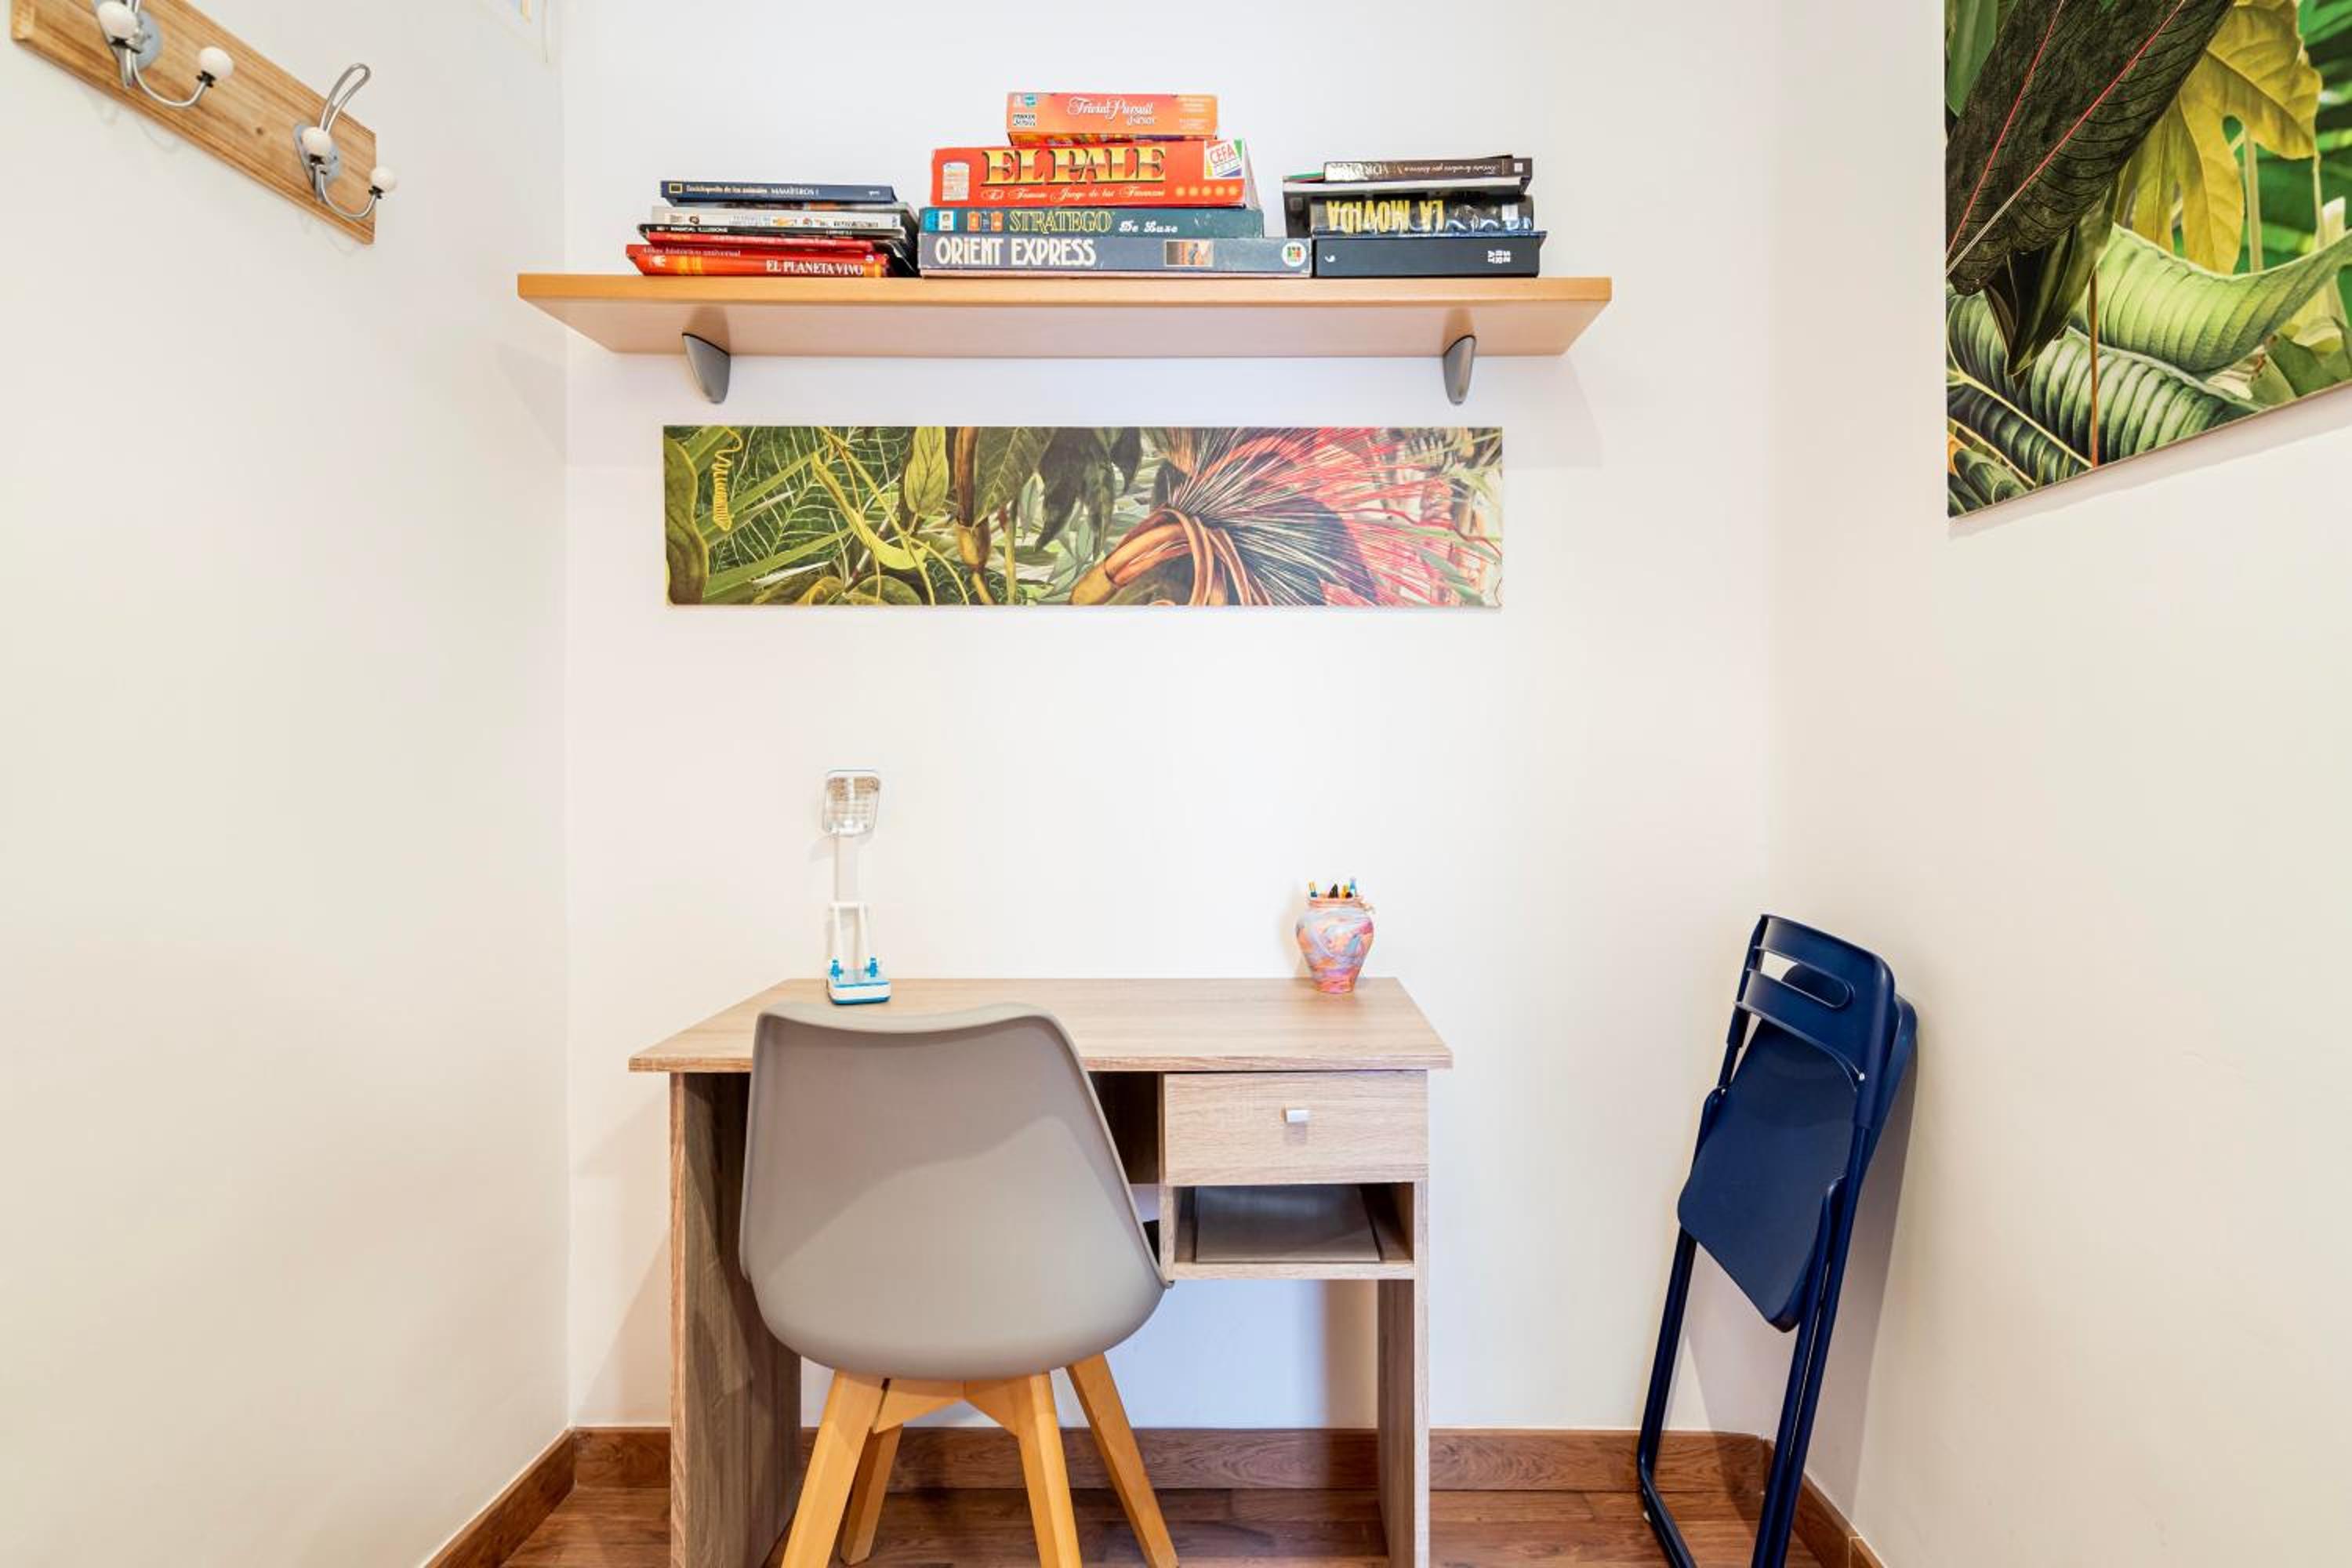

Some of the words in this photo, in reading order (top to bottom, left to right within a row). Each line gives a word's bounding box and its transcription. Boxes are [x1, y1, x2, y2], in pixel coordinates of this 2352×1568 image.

[1067, 96, 1111, 114] Trivial
[1105, 96, 1154, 121] Pursuit
[981, 149, 1045, 186] EL
[1046, 147, 1166, 185] PALE
[1210, 143, 1236, 164] CEFA
[1009, 210, 1112, 234] STRATEGO
[1119, 220, 1138, 233] De
[1143, 220, 1178, 233] Luxe
[1326, 199, 1410, 233] MOVIDA
[1419, 199, 1445, 231] LA
[1011, 238, 1097, 267] EXPRESS
[765, 260, 782, 272] EL
[784, 261, 837, 274] PLANETA
[836, 263, 863, 275] VIVO
